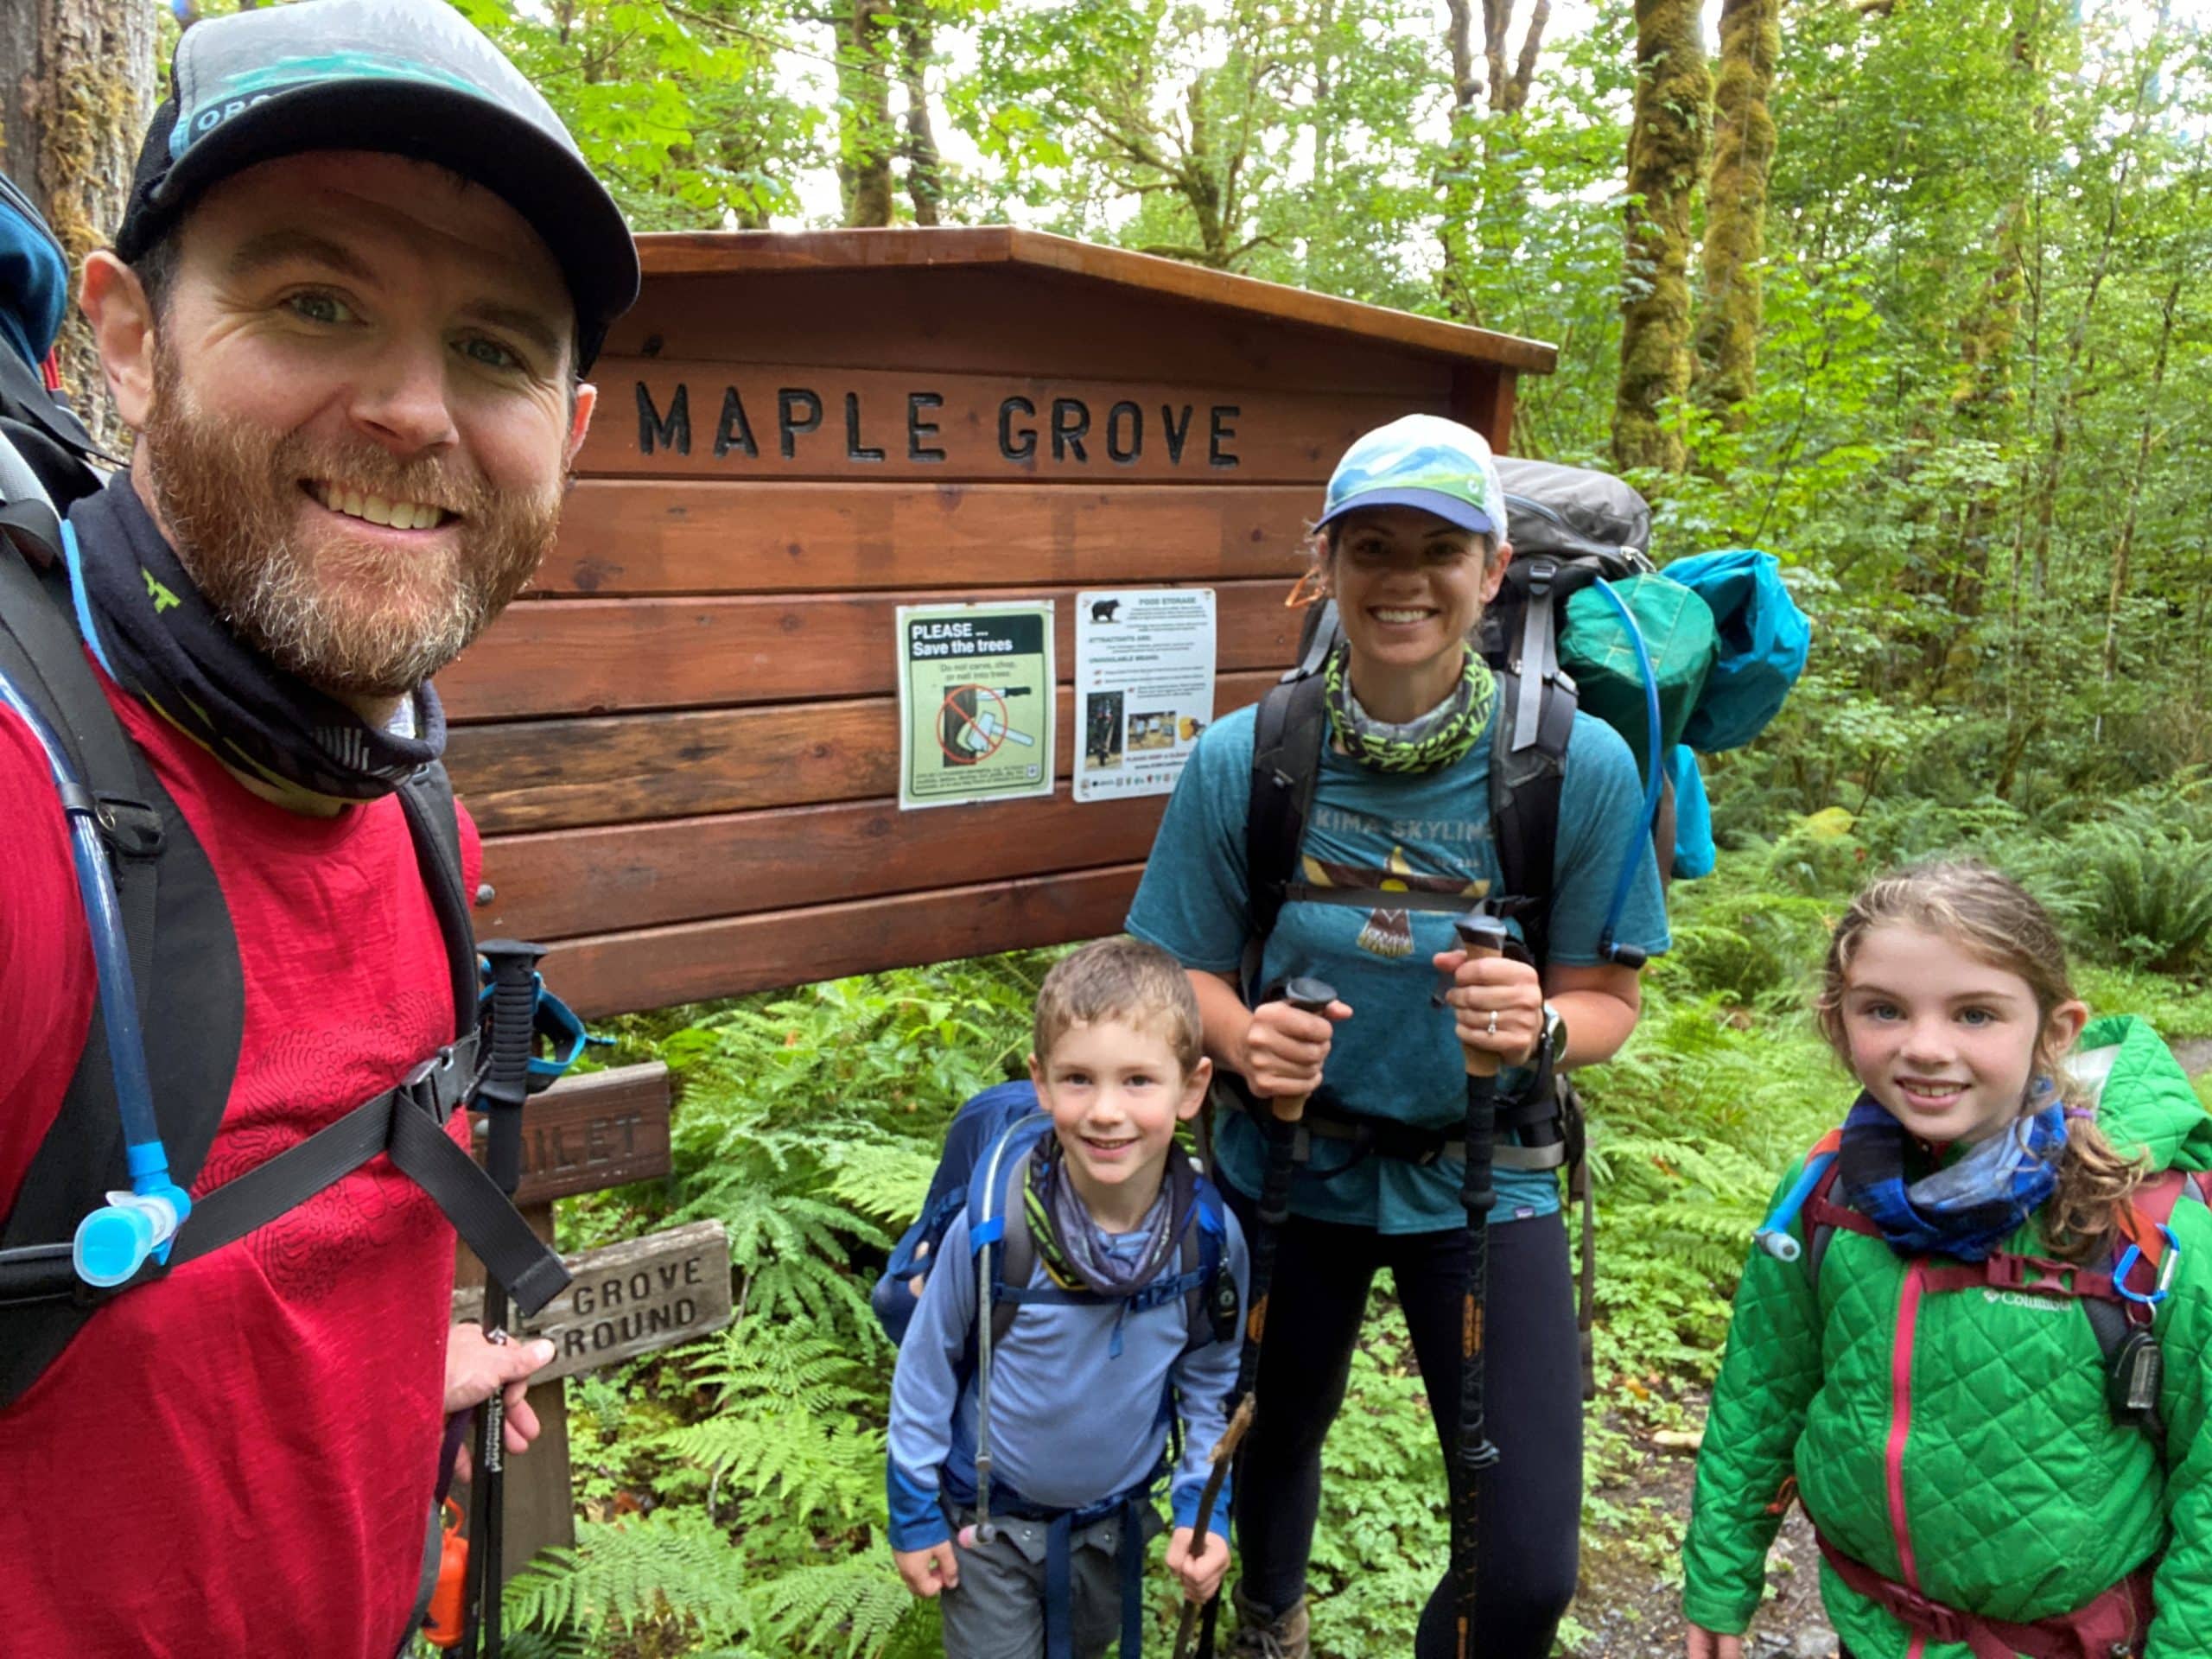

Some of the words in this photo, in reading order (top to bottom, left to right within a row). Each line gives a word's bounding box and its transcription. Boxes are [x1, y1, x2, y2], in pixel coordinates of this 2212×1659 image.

[636, 381, 947, 462] MAPLE
[998, 396, 1241, 468] GROVE
[912, 623, 973, 639] PLEASE
[912, 641, 949, 657] Save
[951, 639, 975, 654] the
[977, 639, 1014, 652] trees
[573, 1257, 703, 1315] GROVE
[2001, 1291, 2072, 1312] Columbia
